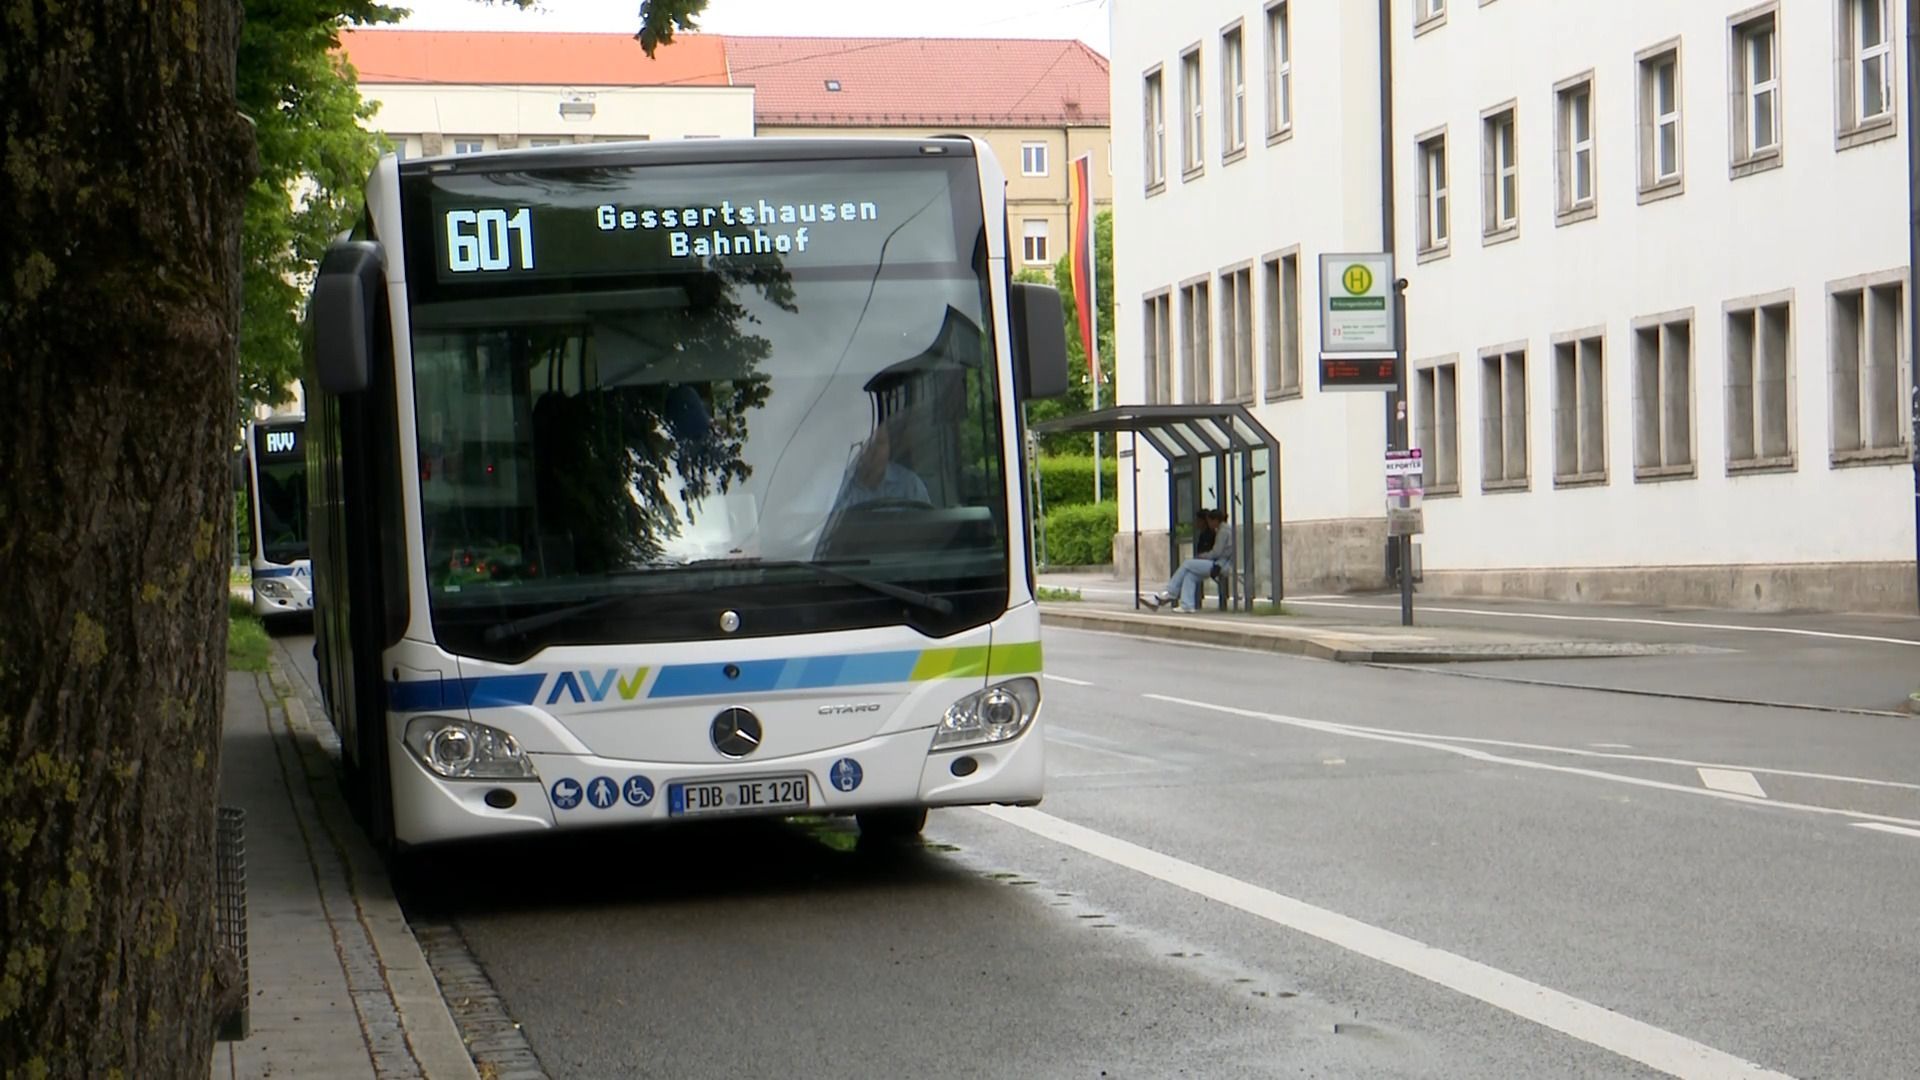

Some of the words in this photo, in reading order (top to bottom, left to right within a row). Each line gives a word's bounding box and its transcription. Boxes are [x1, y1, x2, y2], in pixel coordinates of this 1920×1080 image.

[596, 200, 879, 231] Gessertshausen
[446, 208, 536, 272] 601
[669, 227, 811, 258] Bahnhof
[1350, 271, 1363, 289] H
[266, 432, 295, 452] AVV
[546, 666, 650, 705] AVV
[818, 704, 880, 715] CITARO
[685, 786, 724, 809] FDB
[739, 783, 764, 805] DE
[768, 781, 805, 803] 120
